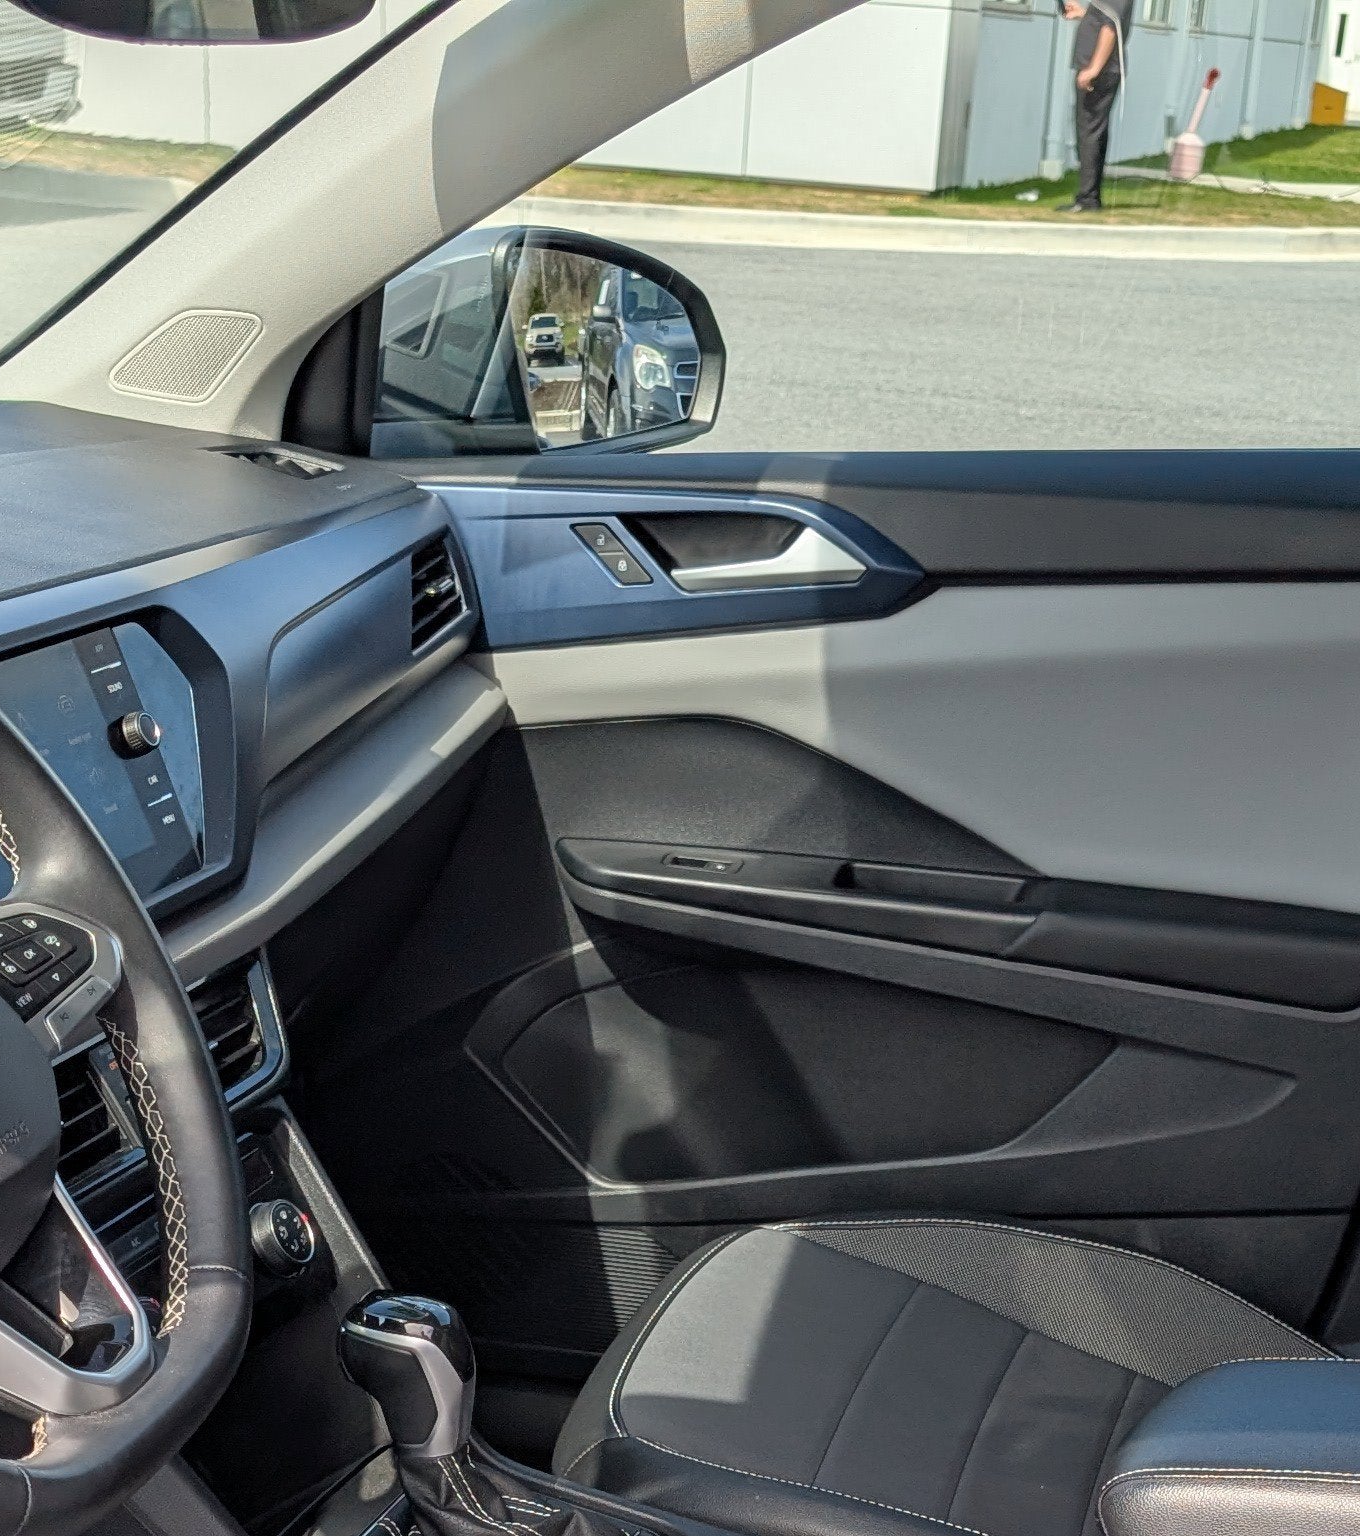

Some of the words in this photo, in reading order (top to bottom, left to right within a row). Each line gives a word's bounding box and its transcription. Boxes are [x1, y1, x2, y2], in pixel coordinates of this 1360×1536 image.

[107, 681, 123, 694] SOUND
[147, 774, 159, 786] CAR
[162, 812, 176, 826] MENU
[23, 948, 37, 960] OK
[15, 992, 34, 1008] VIEW
